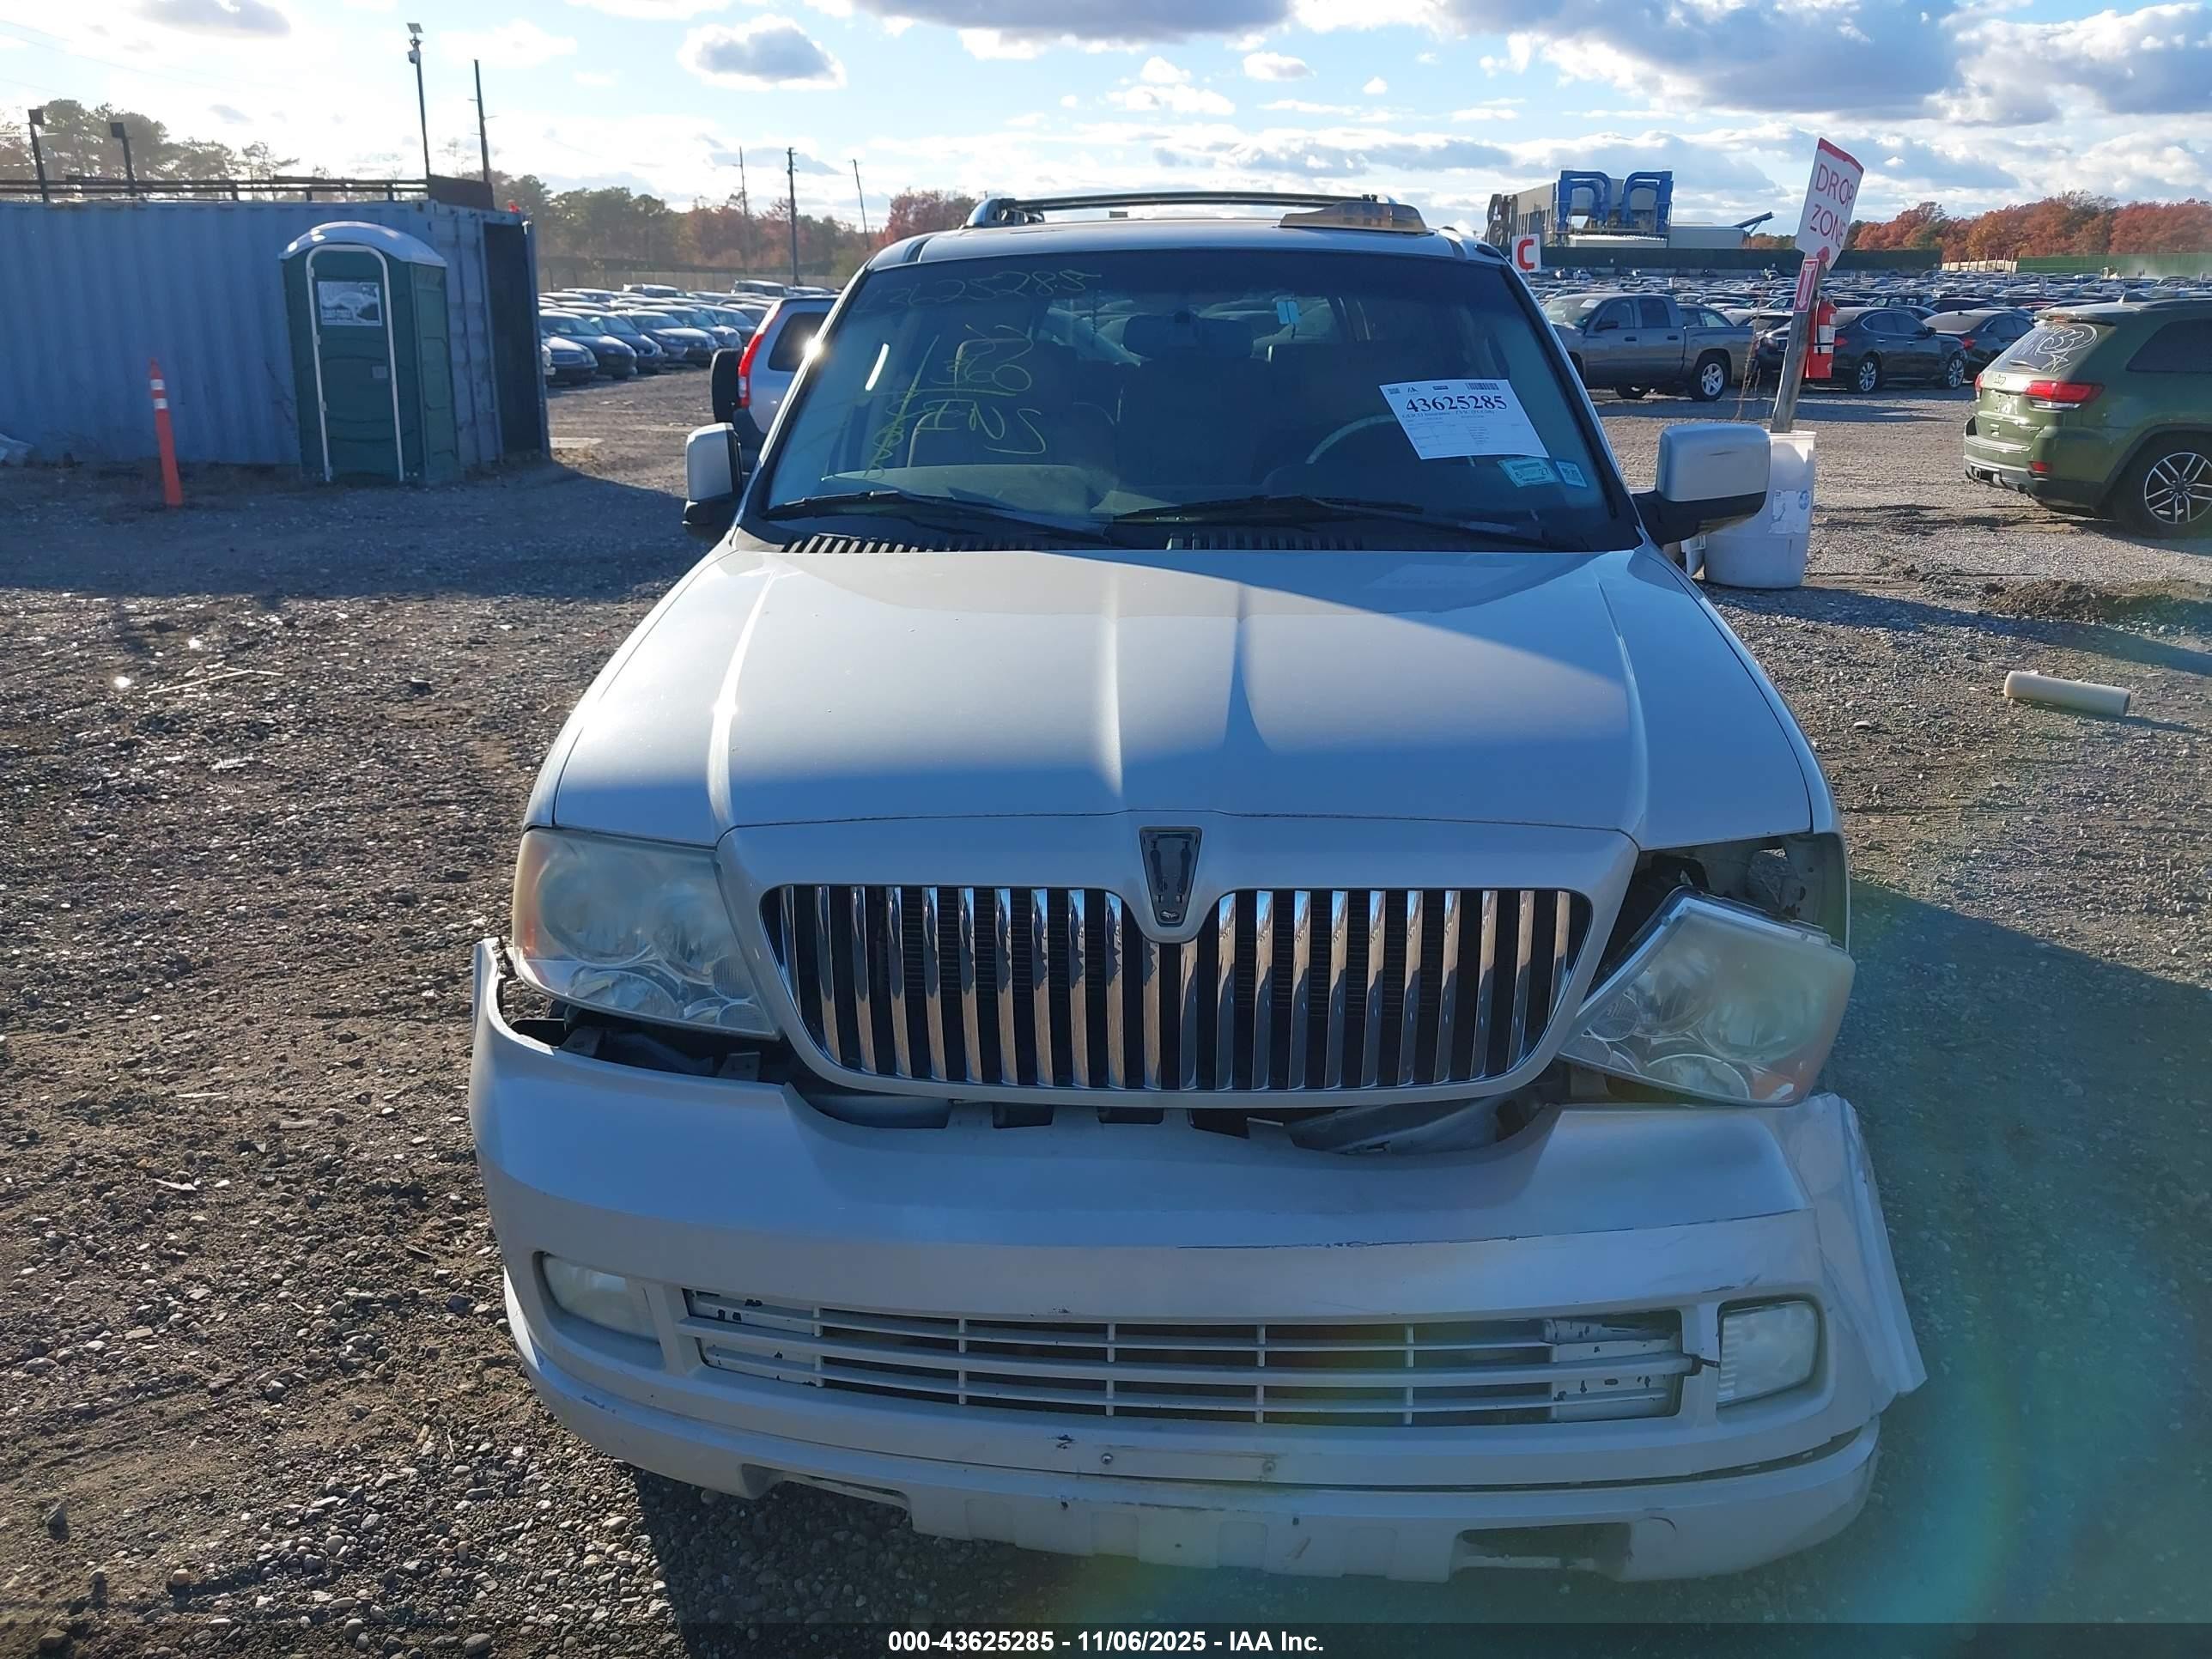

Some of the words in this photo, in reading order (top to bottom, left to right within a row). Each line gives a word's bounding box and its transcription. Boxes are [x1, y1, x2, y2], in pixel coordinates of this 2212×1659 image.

[1814, 162, 1855, 210] DROP
[1809, 203, 1846, 249] ZONE
[1516, 238, 1535, 270] C
[1406, 394, 1508, 413] 43625285
